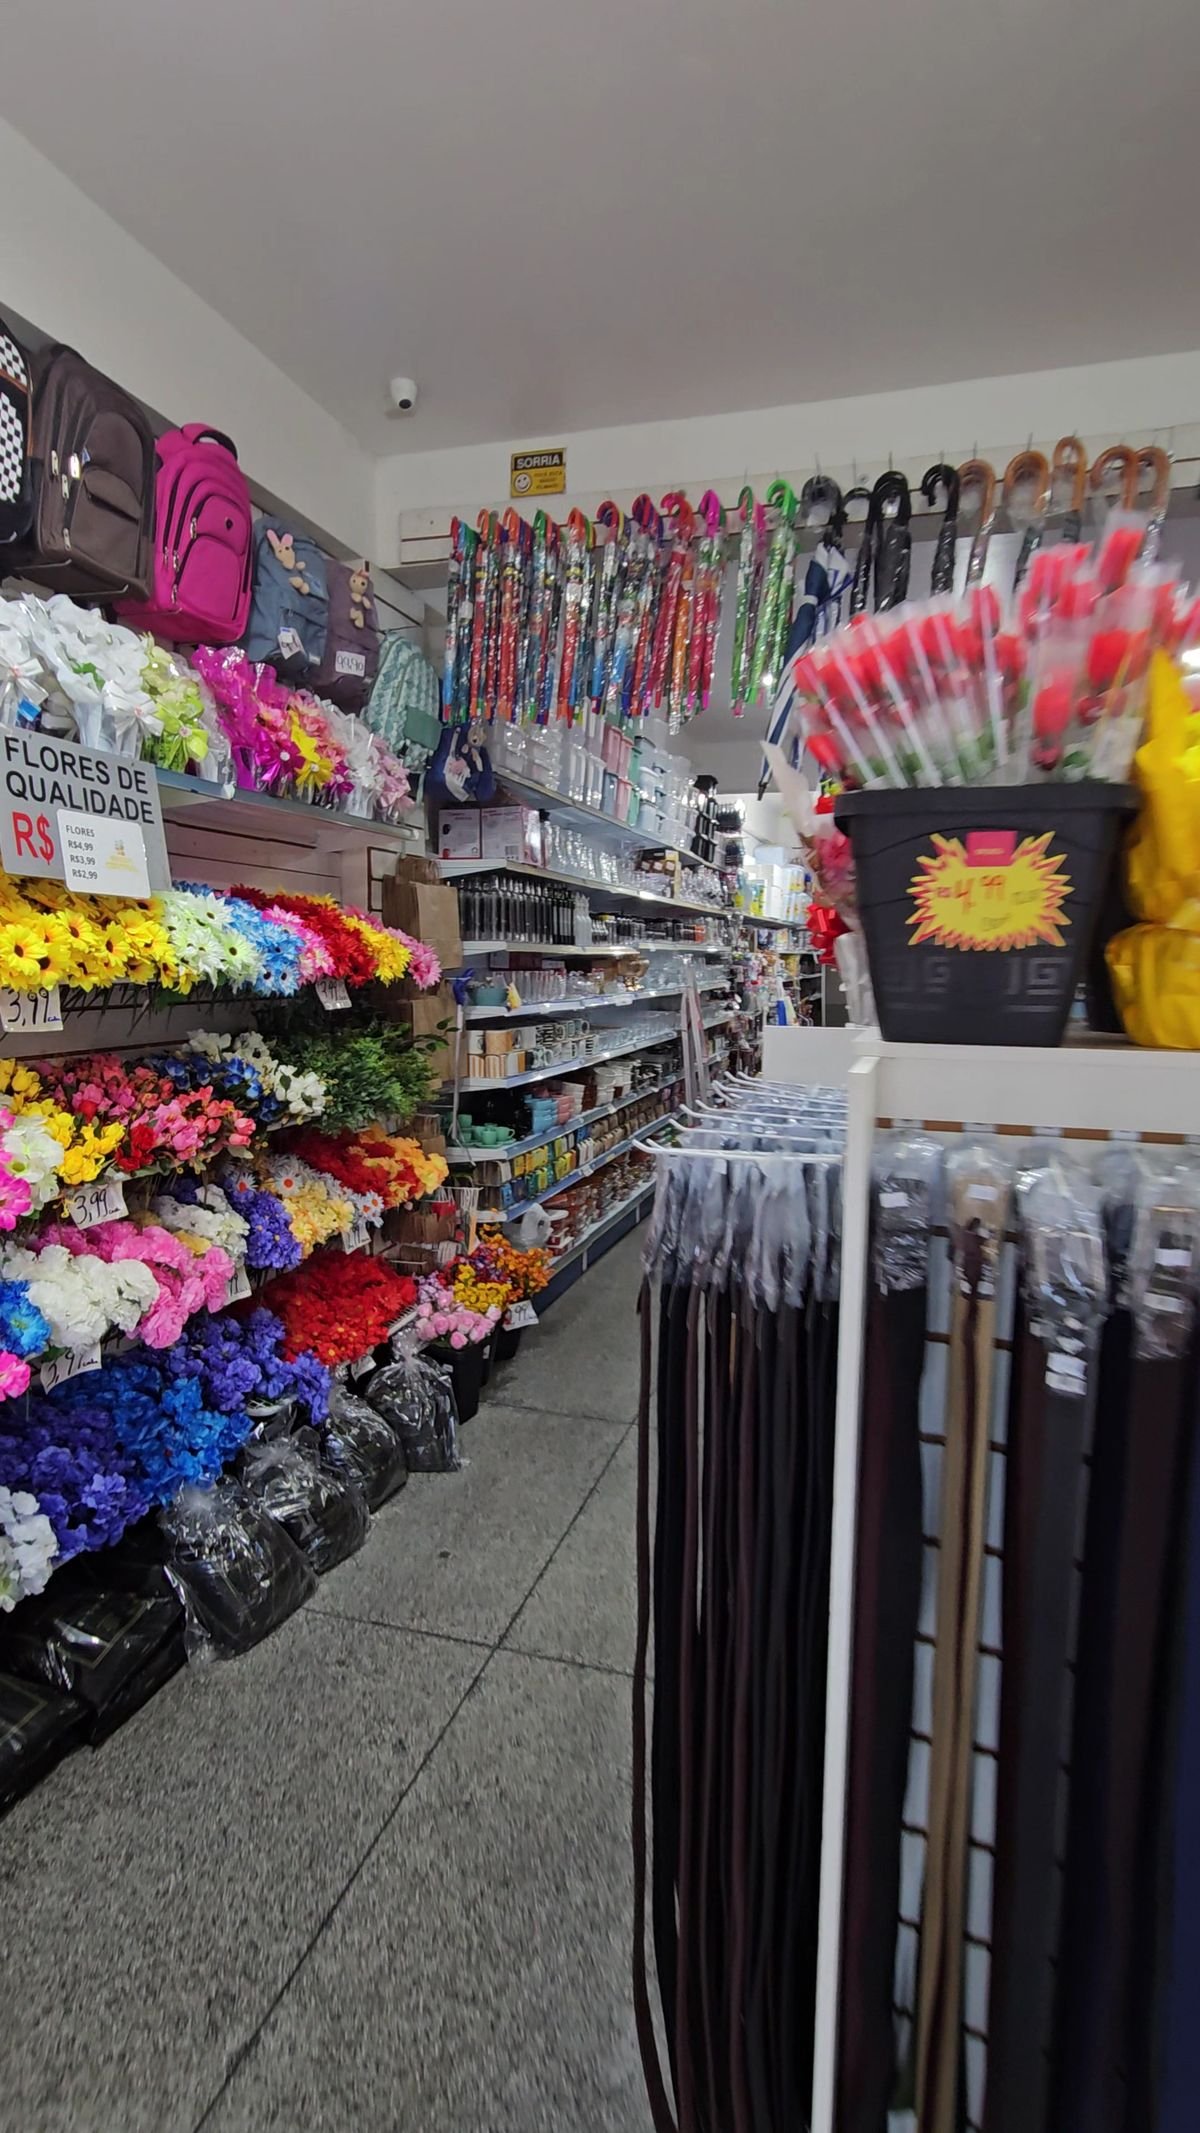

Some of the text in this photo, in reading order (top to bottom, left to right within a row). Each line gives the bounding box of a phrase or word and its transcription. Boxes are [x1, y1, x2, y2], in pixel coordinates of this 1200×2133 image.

[516, 454, 561, 469] SORRIA
[4, 736, 149, 795] FLORES DE
[5, 770, 155, 825] QUALIDADE
[12, 811, 55, 866] R$
[65, 824, 96, 838] FLORES
[67, 839, 94, 852] R$4,99
[70, 854, 96, 866] R$3,99
[71, 868, 98, 880] R$2,99
[74, 1188, 109, 1225] 3,99
